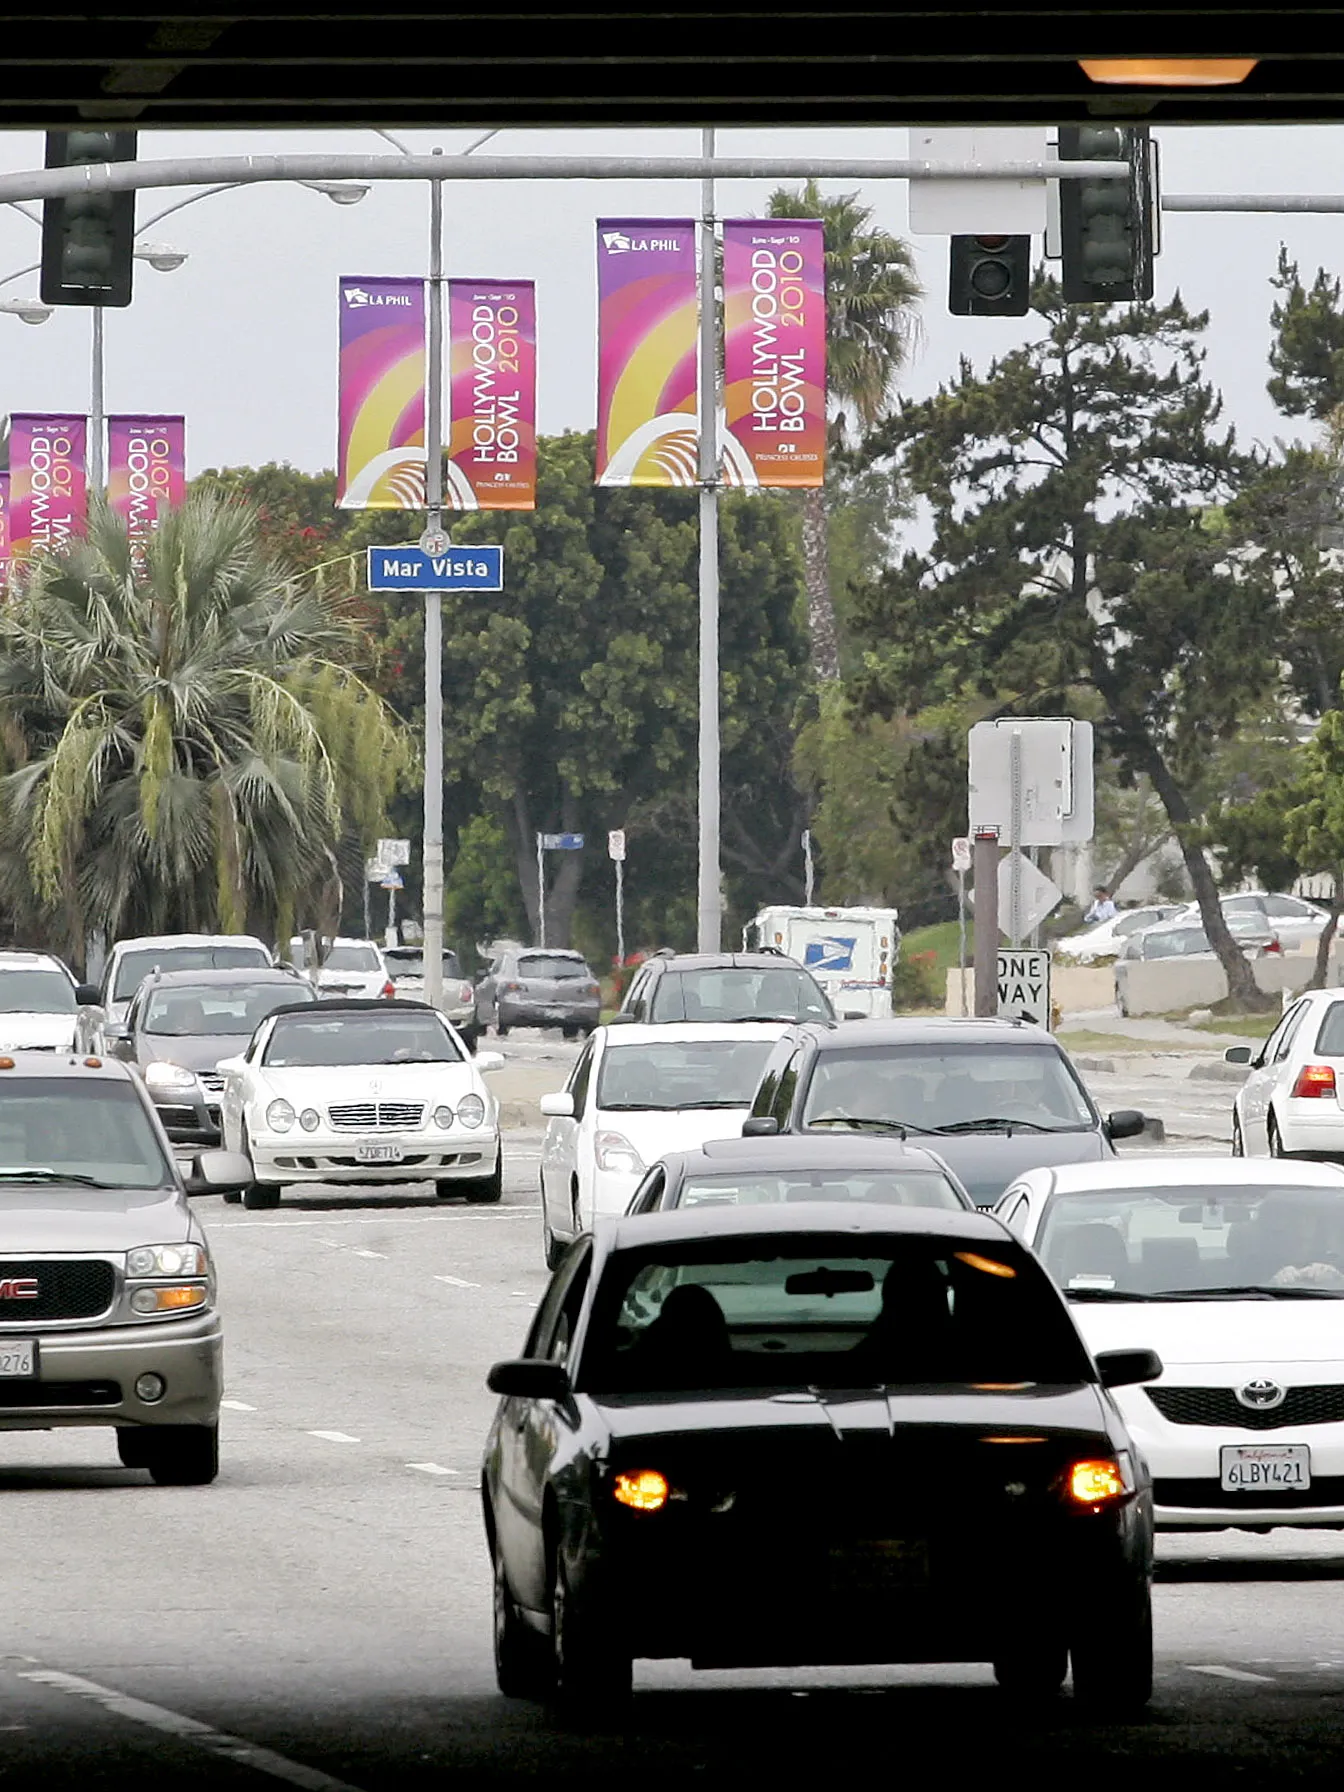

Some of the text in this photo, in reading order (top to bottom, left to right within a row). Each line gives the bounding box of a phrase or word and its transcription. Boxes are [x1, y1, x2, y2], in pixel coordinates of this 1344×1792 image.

[631, 239, 680, 251] LA PHIL
[369, 295, 412, 306] LA PHIL
[751, 249, 778, 431] HOLLYWOOD
[779, 250, 805, 431] BOWL 2010
[472, 305, 496, 462] HOLLYWOOD
[496, 306, 520, 463] BOWL 2010
[30, 437, 50, 556] OLLYWOOD
[53, 437, 72, 498] 2010
[150, 438, 171, 499] 2010
[383, 559, 488, 577] Mar Vista
[997, 957, 1041, 977] ONE
[1228, 1463, 1303, 1484] 6LBY421
